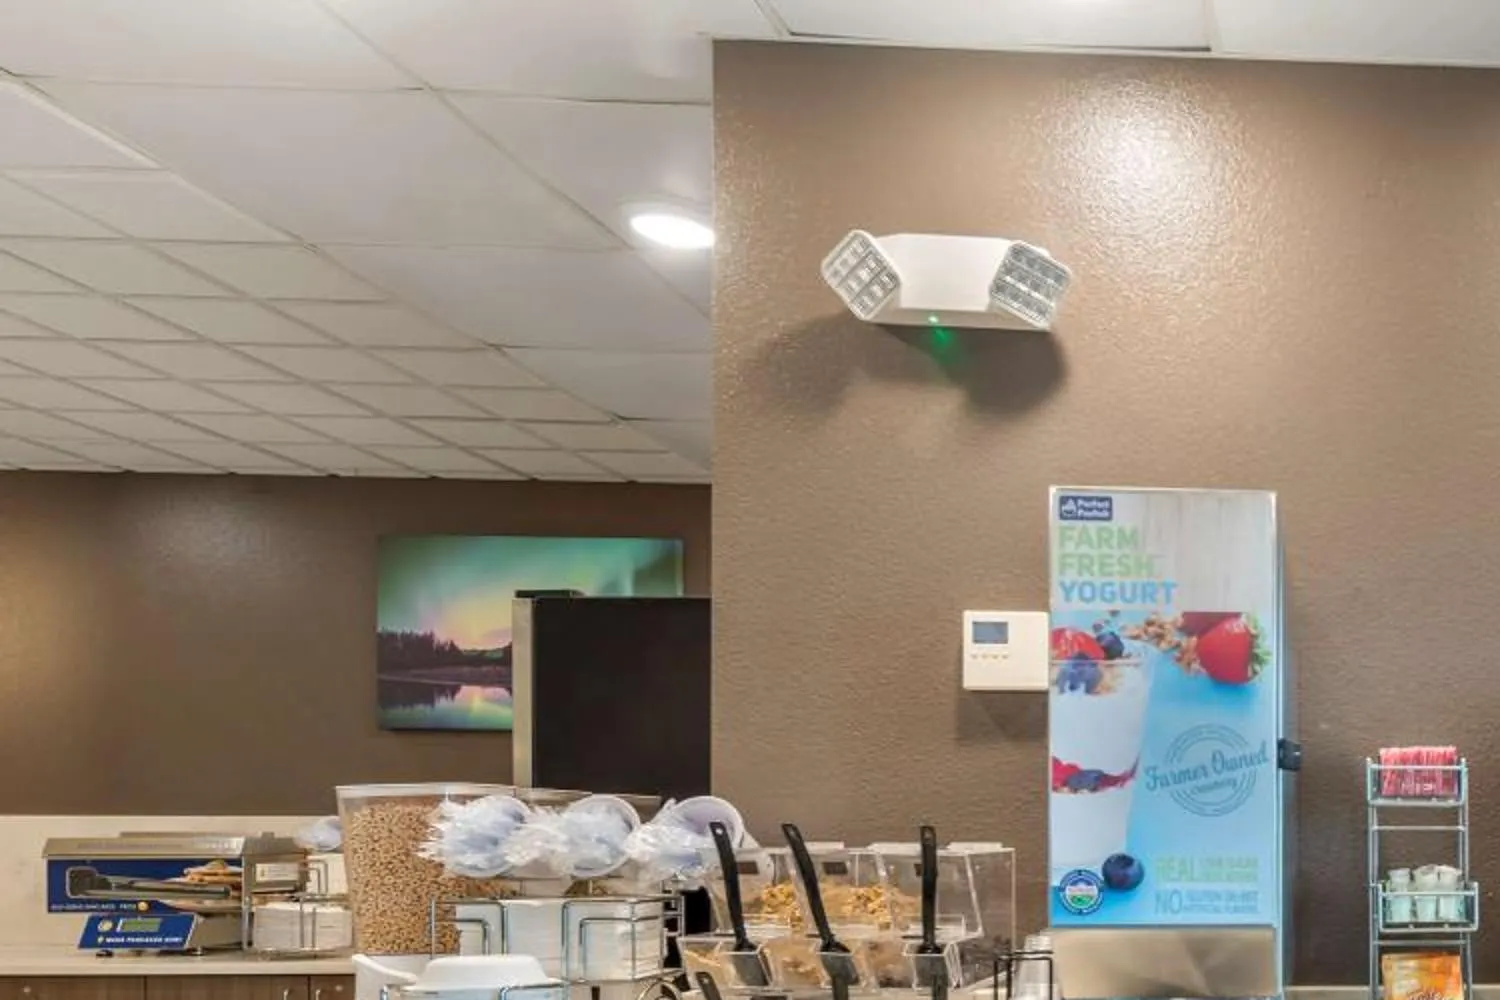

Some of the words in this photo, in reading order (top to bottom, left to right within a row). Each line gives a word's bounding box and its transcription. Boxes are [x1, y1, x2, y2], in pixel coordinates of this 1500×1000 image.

[1058, 526, 1139, 550] FARM
[1058, 553, 1154, 577] FRESH
[1059, 581, 1178, 604] YOGURT
[1154, 889, 1183, 915] NO
